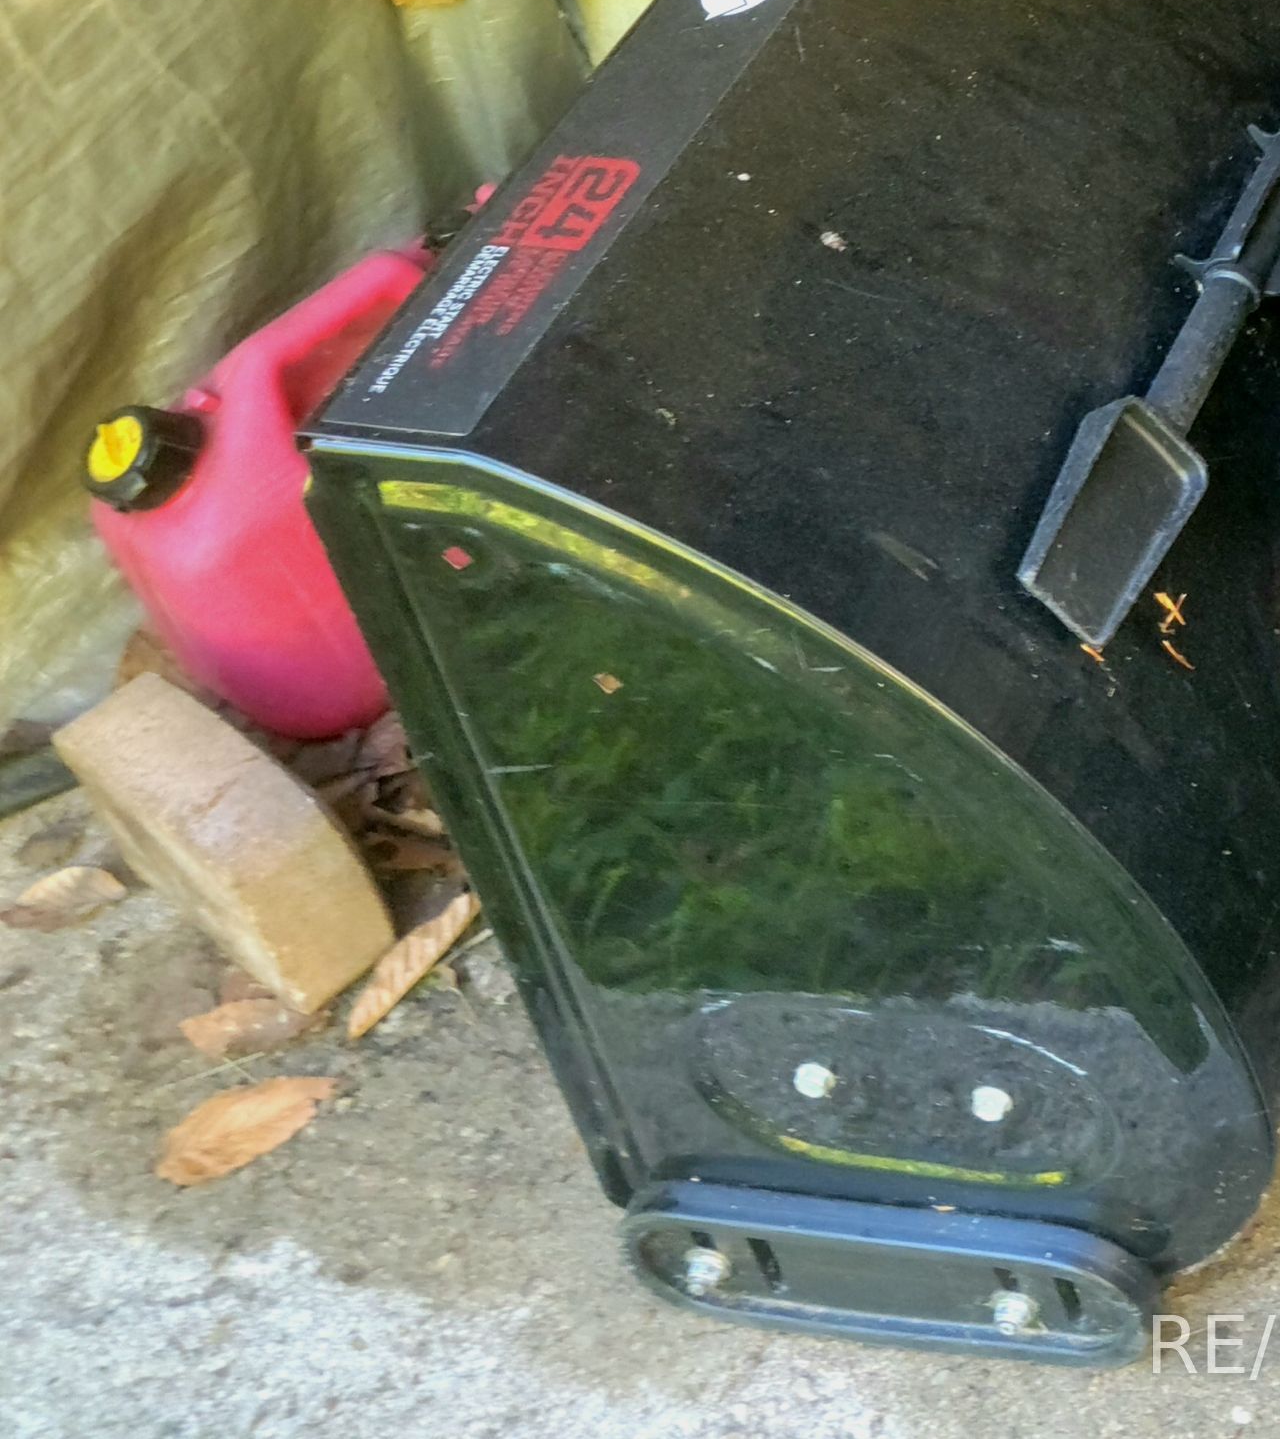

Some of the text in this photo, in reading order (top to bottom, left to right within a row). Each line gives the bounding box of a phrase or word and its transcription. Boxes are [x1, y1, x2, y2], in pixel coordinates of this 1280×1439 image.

[488, 154, 580, 245] INCH
[532, 166, 630, 238] 24
[427, 245, 511, 339] ELECTRIC START
